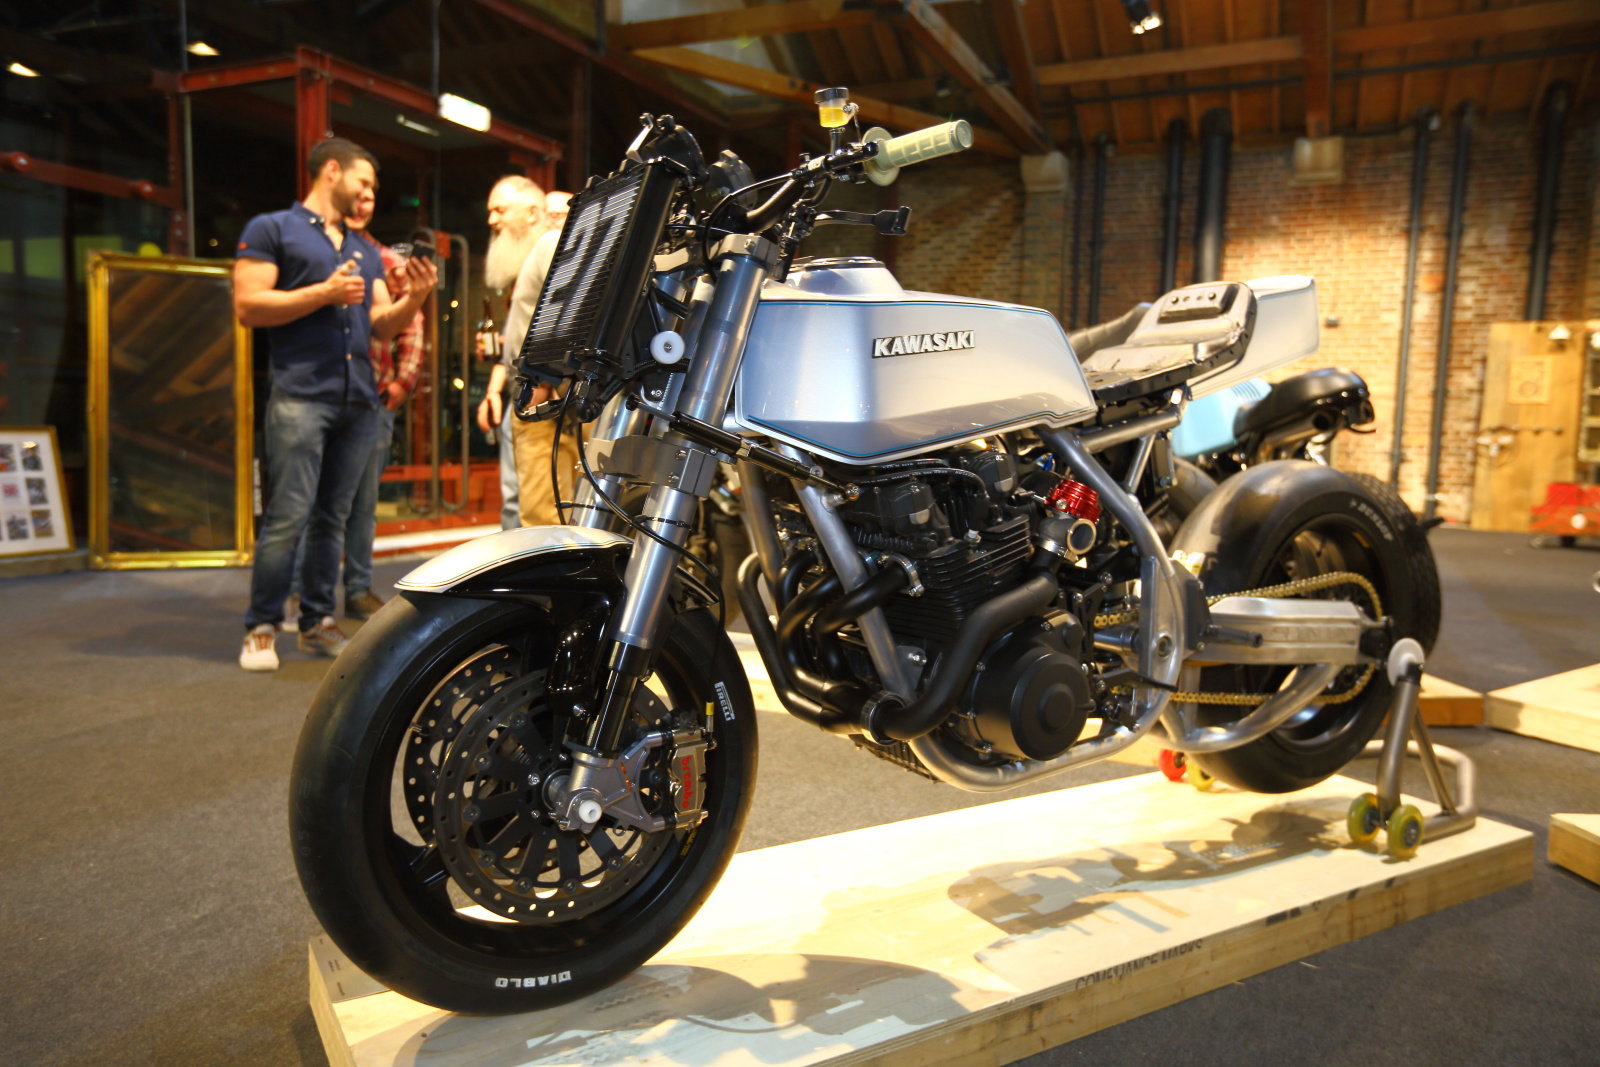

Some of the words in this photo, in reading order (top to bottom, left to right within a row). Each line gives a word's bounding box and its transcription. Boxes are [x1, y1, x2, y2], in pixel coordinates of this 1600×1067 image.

[872, 330, 975, 358] KAWASAKI
[714, 681, 735, 722] PIRELLI
[681, 755, 694, 808] brembo
[495, 970, 572, 988] DIABLO
